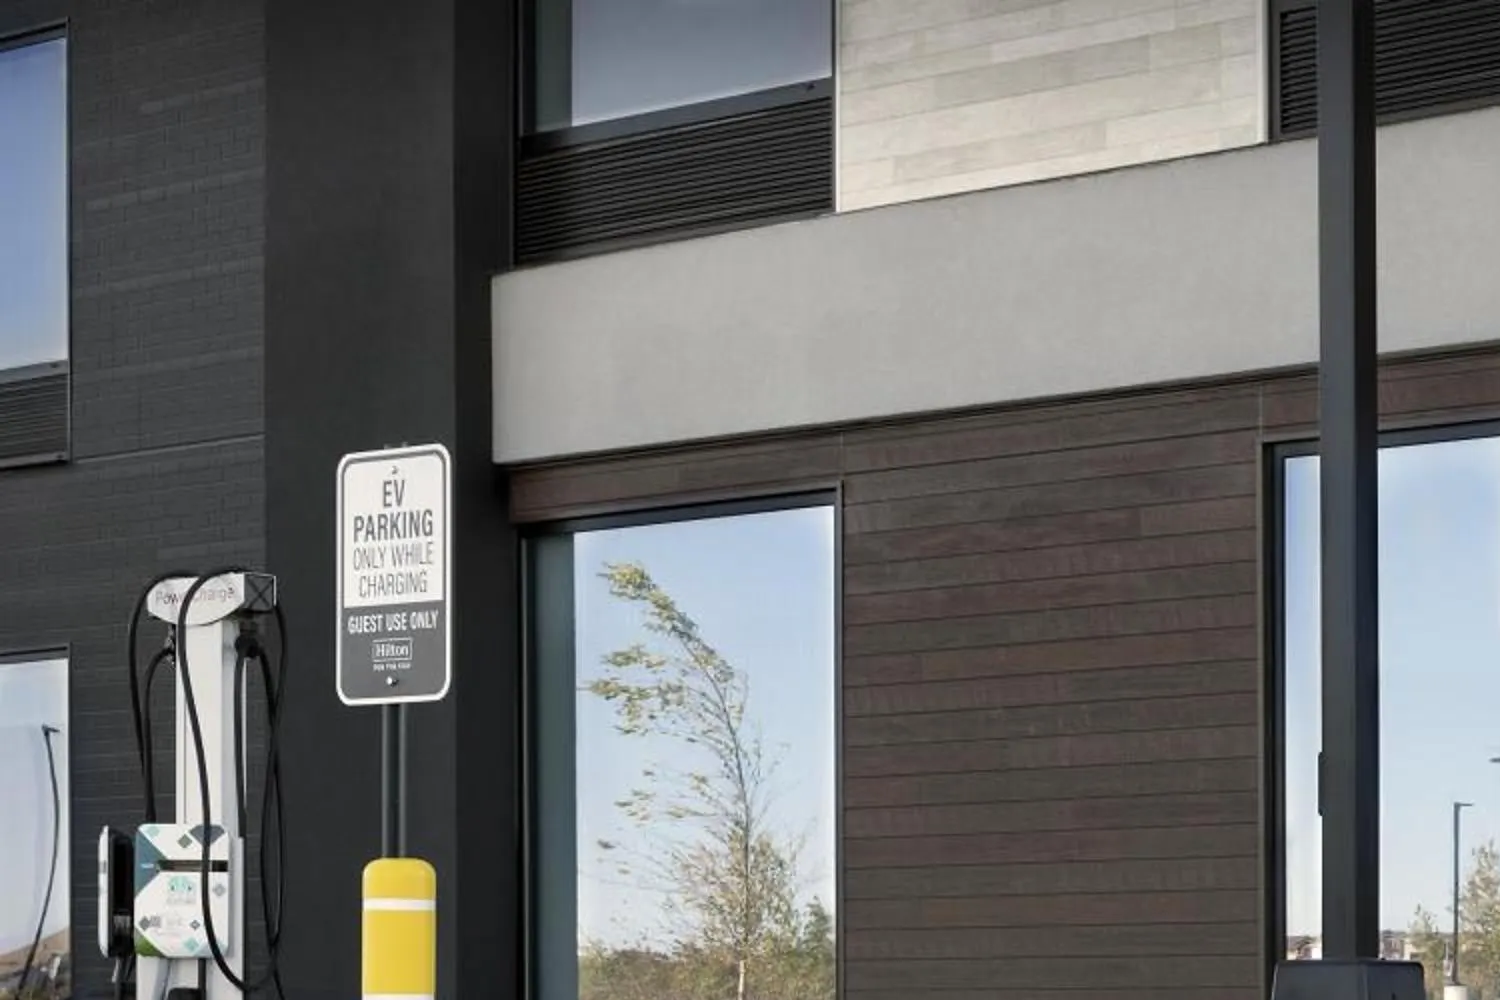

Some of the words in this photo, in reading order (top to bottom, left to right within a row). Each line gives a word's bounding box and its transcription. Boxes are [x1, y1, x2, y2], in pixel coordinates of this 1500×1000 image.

[382, 478, 406, 508] EV
[352, 508, 434, 543] PARKING
[353, 545, 386, 571] ONLY
[390, 540, 434, 567] WHILE
[359, 569, 427, 598] CHARGING
[347, 613, 384, 634] GUEST
[385, 611, 408, 631] USE
[410, 609, 439, 630] ONLY
